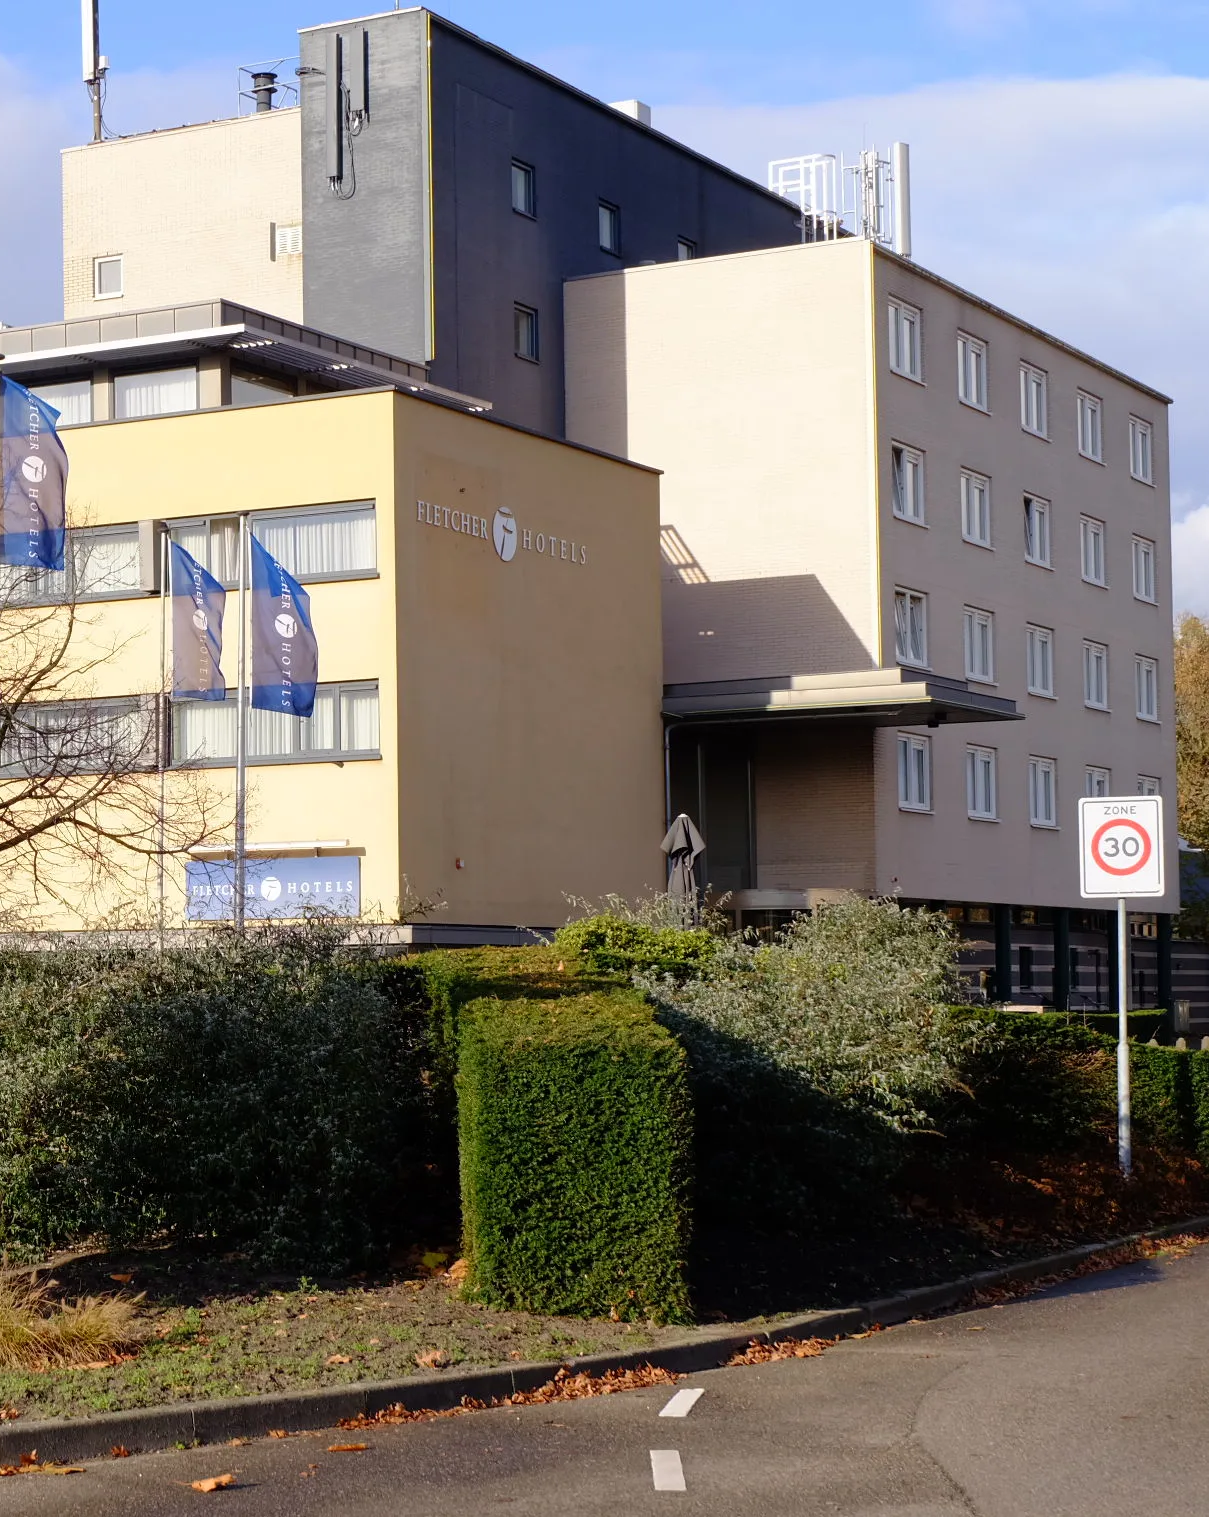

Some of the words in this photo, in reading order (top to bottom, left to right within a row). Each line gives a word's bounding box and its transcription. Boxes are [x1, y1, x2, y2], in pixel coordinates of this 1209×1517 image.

[28, 488, 39, 558] HOTELS
[416, 500, 489, 540] FLETCHER
[522, 528, 587, 565] HOTELS
[281, 642, 292, 707] HOTELS
[1104, 805, 1137, 815] ZONE
[1103, 837, 1140, 857] 30
[288, 880, 353, 895] HOTELS
